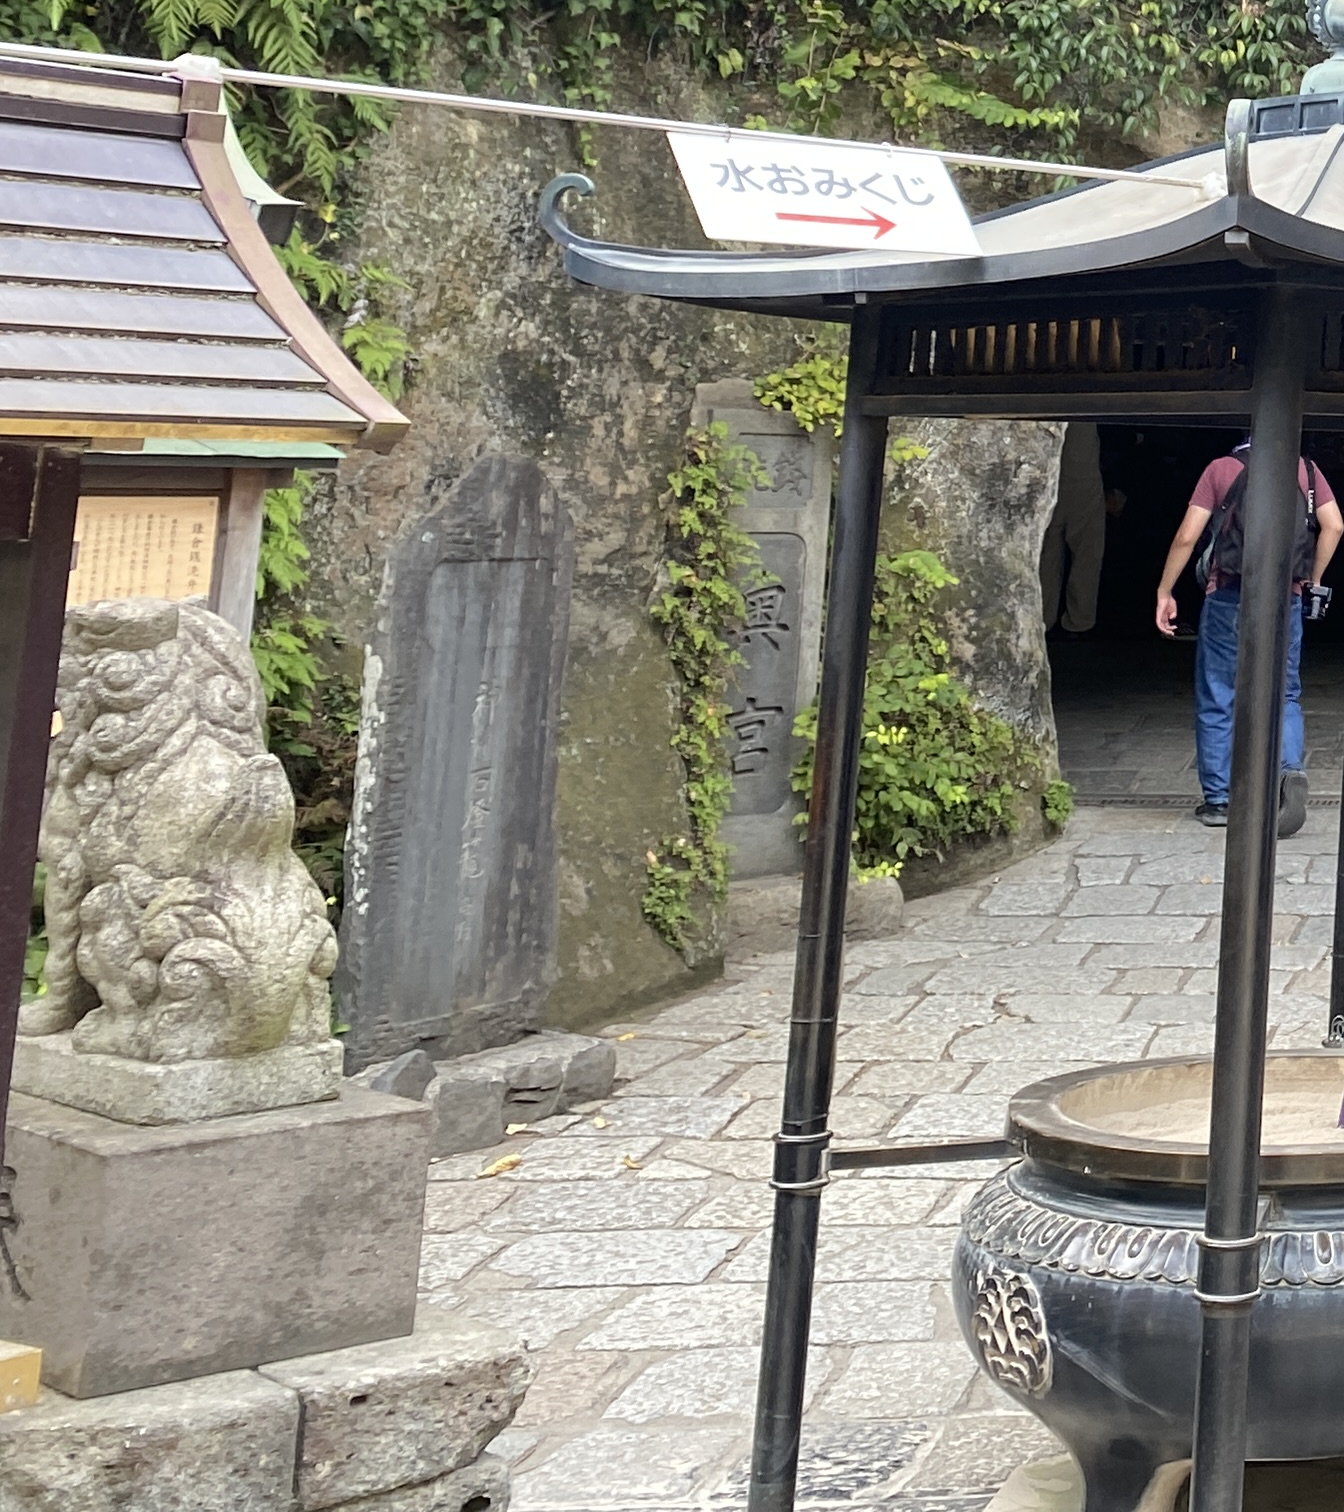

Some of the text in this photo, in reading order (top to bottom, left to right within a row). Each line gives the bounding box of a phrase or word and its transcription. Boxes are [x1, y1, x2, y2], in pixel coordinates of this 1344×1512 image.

[710, 158, 935, 206] 水おみくじ
[727, 568, 790, 776] 奥宮
